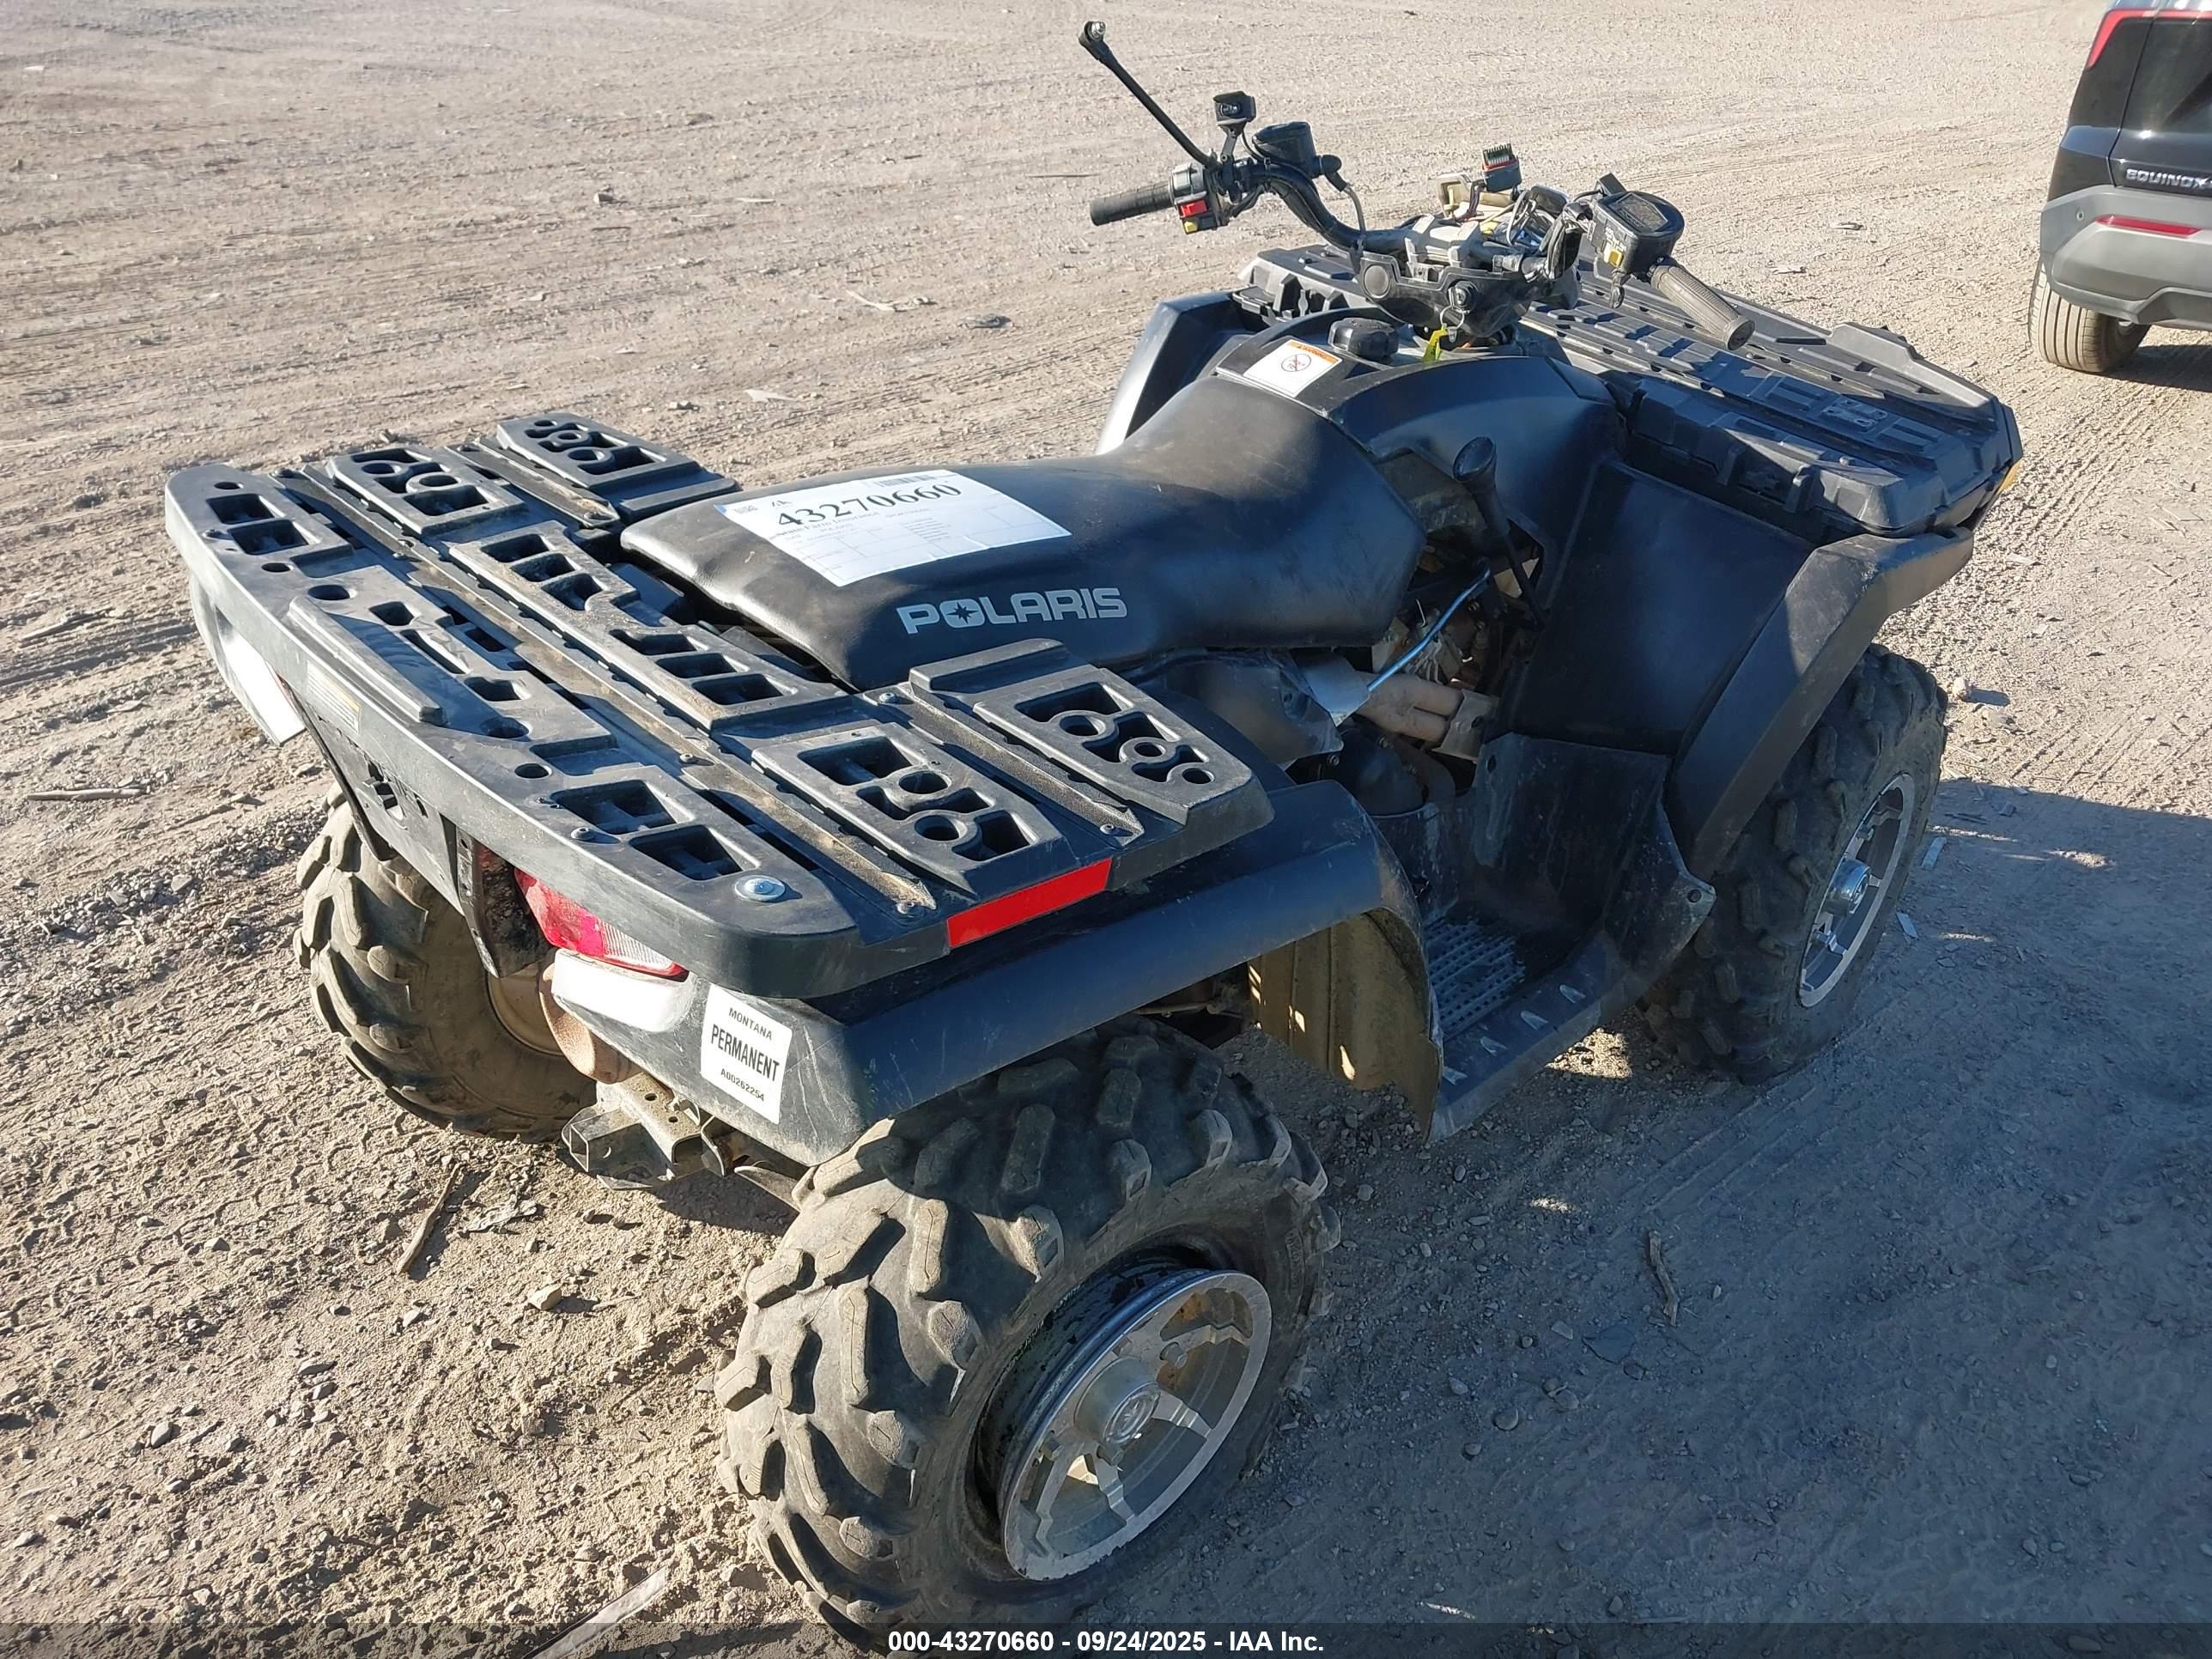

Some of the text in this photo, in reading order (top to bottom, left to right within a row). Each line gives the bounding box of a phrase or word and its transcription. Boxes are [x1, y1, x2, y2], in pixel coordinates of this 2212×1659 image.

[2125, 167, 2207, 190] EQUINOX
[776, 483, 963, 526] 43270660
[895, 586, 1128, 635] POLARIS
[728, 1006, 773, 1042] MONTANA
[710, 1023, 781, 1082] PERMANENT
